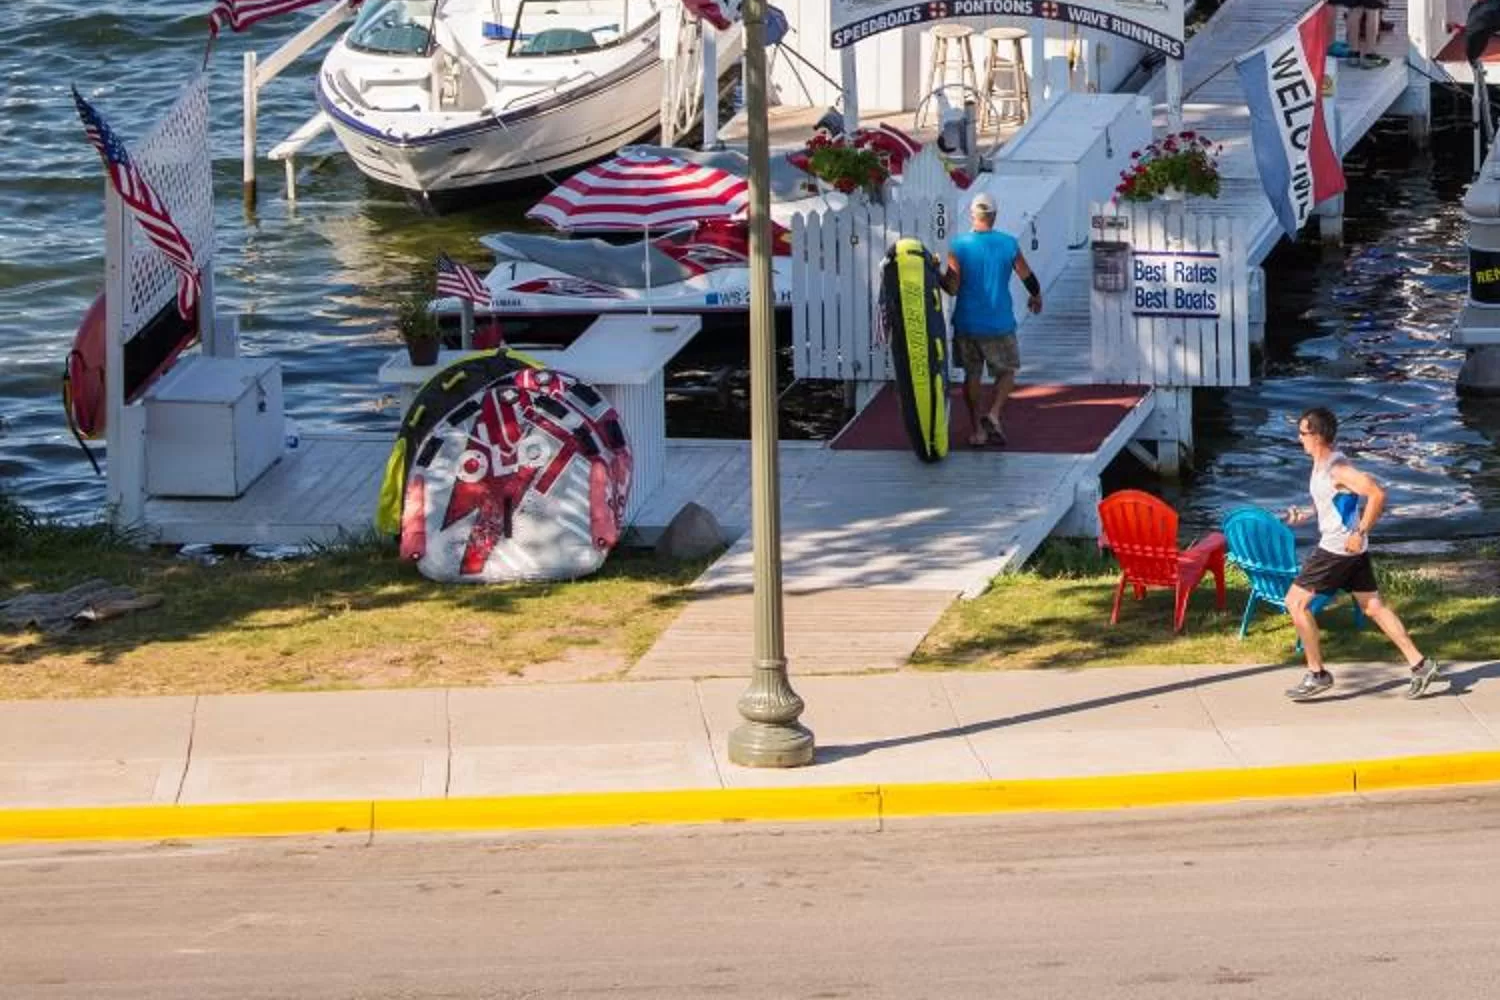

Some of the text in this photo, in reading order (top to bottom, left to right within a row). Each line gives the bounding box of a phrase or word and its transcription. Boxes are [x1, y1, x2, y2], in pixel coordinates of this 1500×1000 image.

[834, 0, 1182, 58] SPEEDBOATS PONTOONS WAVE RUNNERS
[1271, 46, 1317, 221] WELC
[508, 262, 517, 281] 1
[1134, 260, 1168, 282] Best
[1173, 261, 1217, 284] Rates
[1135, 287, 1217, 310] Best Boats
